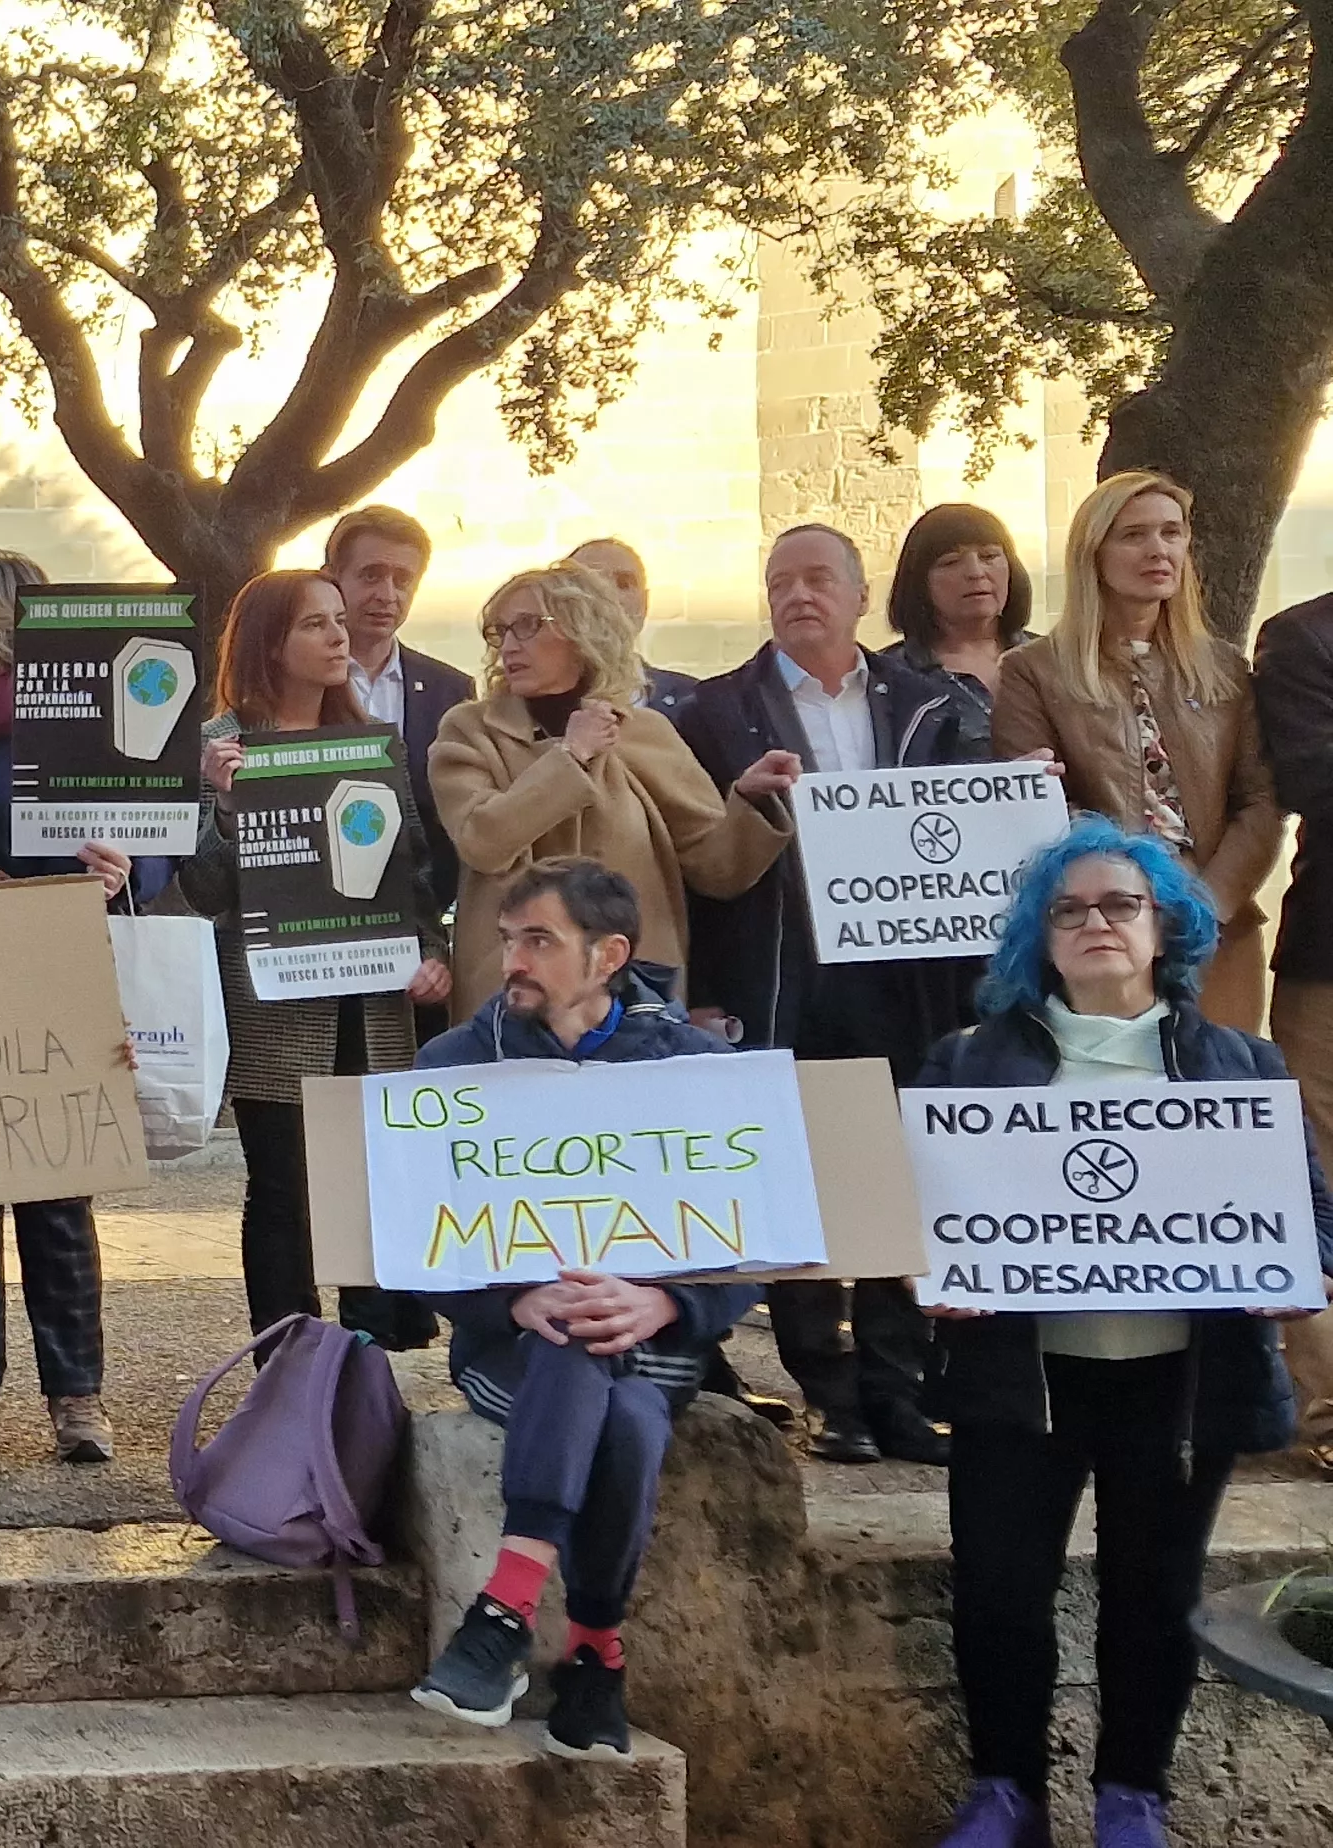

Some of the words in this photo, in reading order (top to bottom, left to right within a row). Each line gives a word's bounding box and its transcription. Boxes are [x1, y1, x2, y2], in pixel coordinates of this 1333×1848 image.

[30, 603, 58, 618] ¡NOS
[61, 602, 112, 618] QUIEREN
[116, 602, 183, 617] ENTERRAR!
[16, 662, 109, 679] ENTIERRO
[16, 680, 43, 692] POR
[52, 679, 70, 692] LA
[15, 690, 93, 705] COOPERACIÓN
[15, 706, 103, 720] INTERNACIONAL
[273, 750, 320, 766] QUIEREN
[323, 744, 382, 762] ENTERRAR!
[810, 783, 860, 812] NO
[867, 781, 906, 810] AL
[911, 773, 1048, 807] RECORTE
[20, 810, 33, 821] NO
[38, 810, 50, 821] AL
[55, 810, 99, 821] RECORTE
[104, 810, 117, 821] EN
[121, 809, 189, 821] COOPERACIÓN
[237, 807, 323, 828] ENTIERRO
[41, 826, 86, 839] HUESCA
[91, 826, 104, 838] ES
[109, 826, 168, 839] SOLIDARIA
[238, 829, 264, 841] POR
[271, 826, 288, 838] LA
[239, 836, 310, 855] COOPERACIÓN
[239, 850, 321, 869] INTERNACIONAL
[826, 859, 1025, 905] COOPERACIÓ
[837, 921, 876, 949] AL
[256, 957, 268, 968] NO
[272, 956, 284, 966] AL
[287, 953, 328, 966] RECORTE
[332, 951, 343, 961] EN
[347, 943, 412, 960] COOPERACIÓN
[278, 968, 318, 984] HUESCA
[323, 968, 334, 980] ES
[339, 961, 396, 978] SOLIDARIA
[381, 1085, 486, 1130] LOS
[925, 1103, 994, 1135] NO
[1003, 1102, 1061, 1133] AL
[1070, 1097, 1276, 1131] RECORTE
[449, 1126, 765, 1181] RECORTES
[932, 1201, 1287, 1245] COOPERACIÓN
[426, 1197, 744, 1273] MATAN
[941, 1263, 995, 1294] AL
[1002, 1263, 1296, 1295] DESARROLLO
